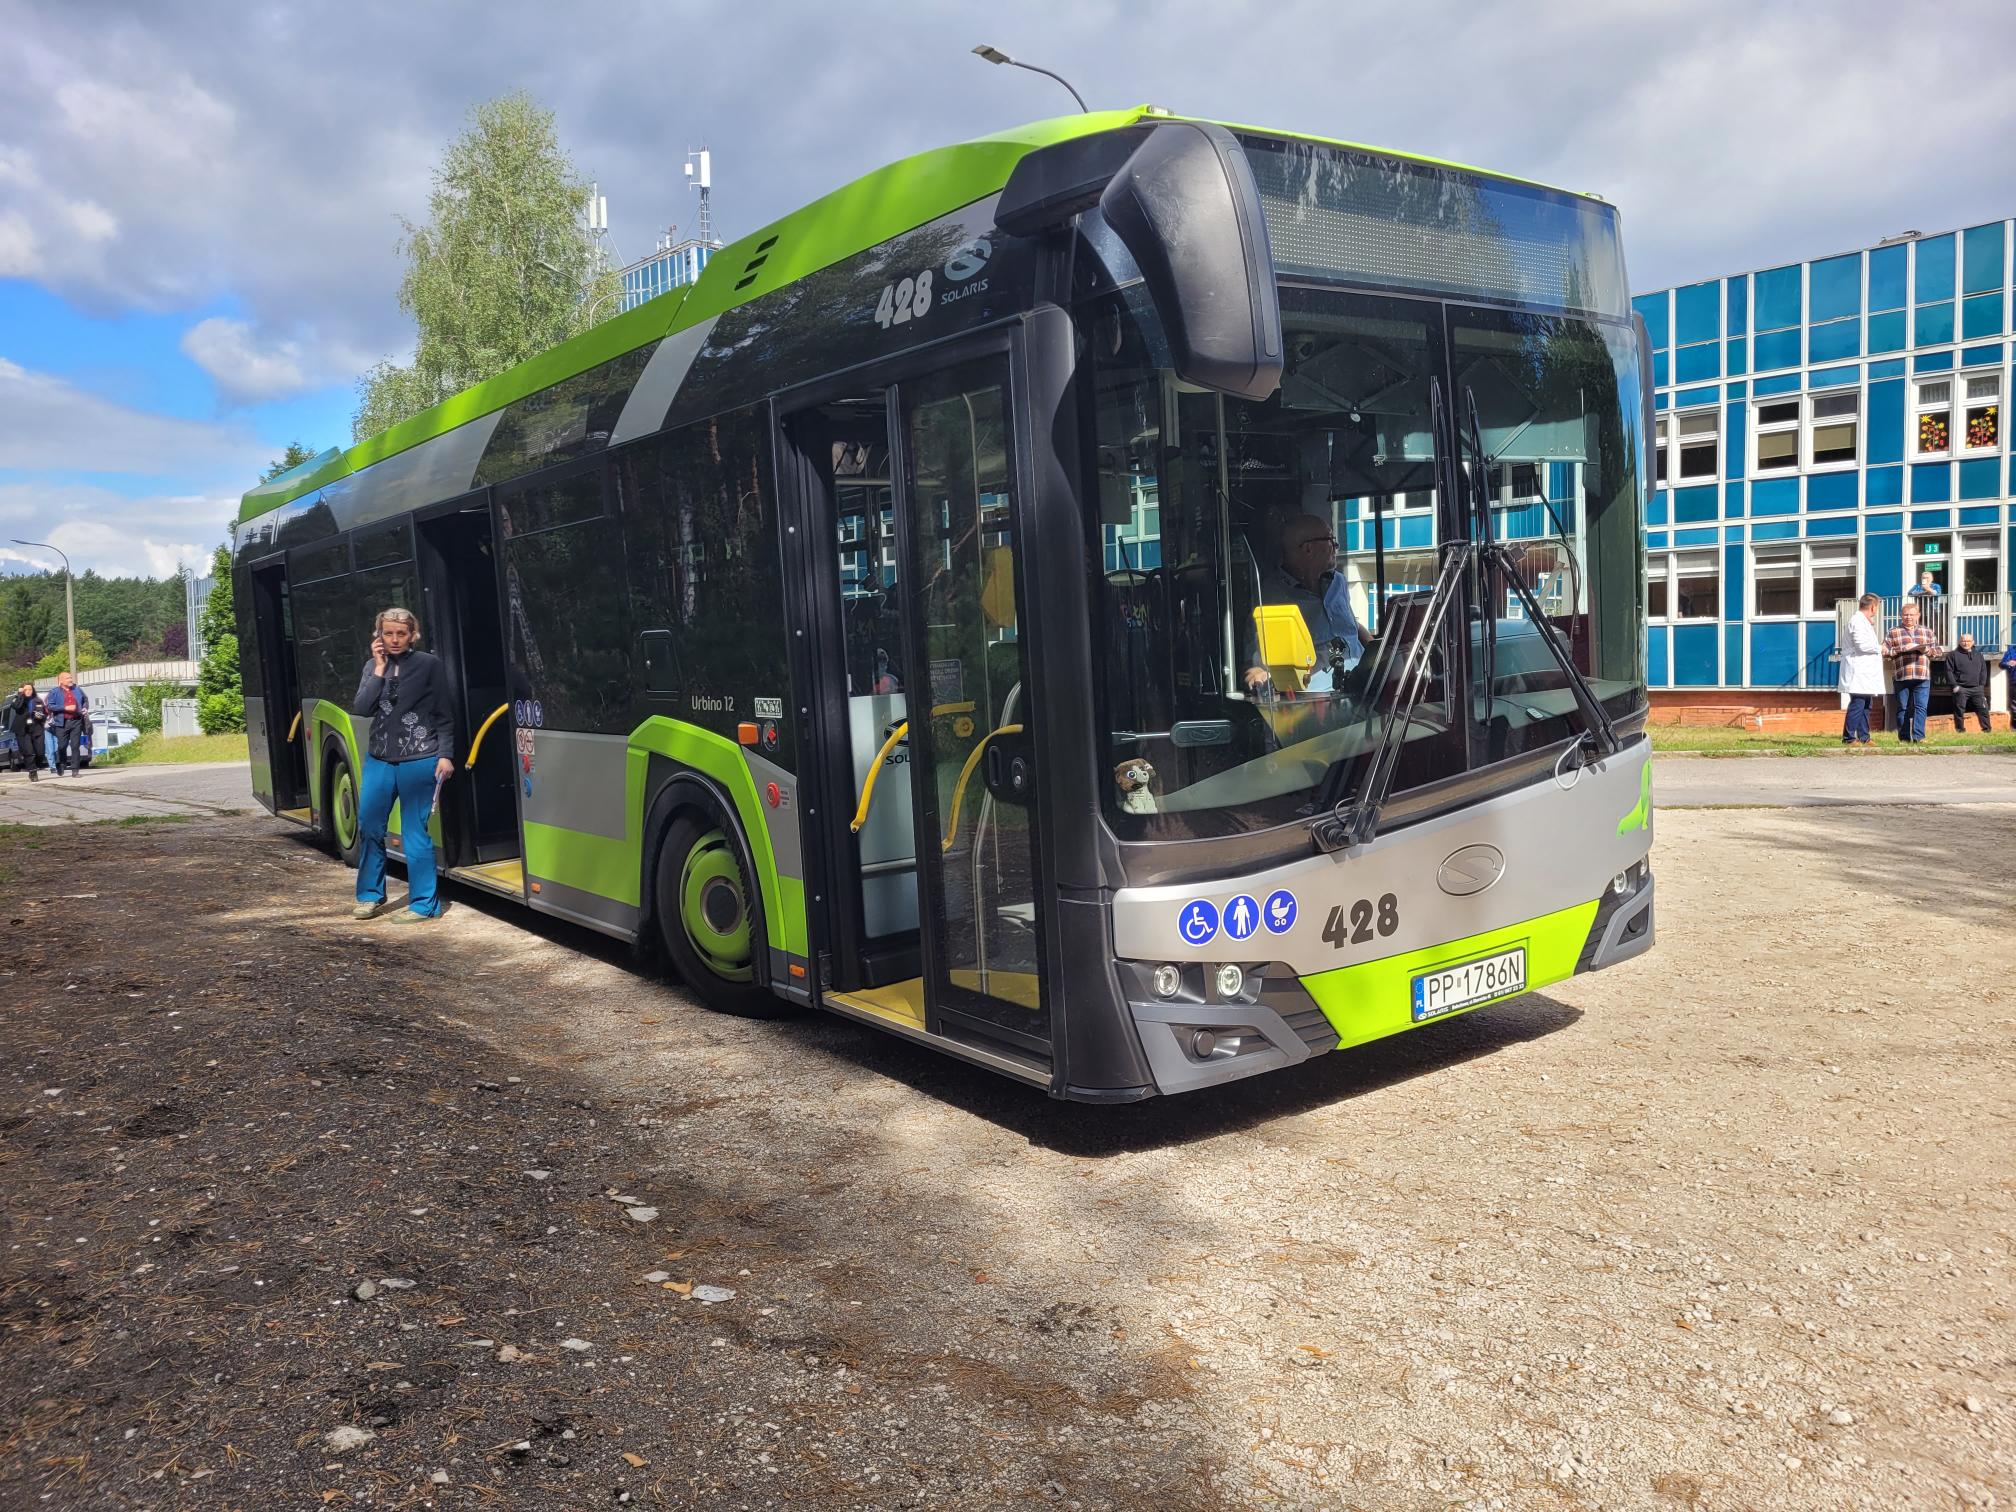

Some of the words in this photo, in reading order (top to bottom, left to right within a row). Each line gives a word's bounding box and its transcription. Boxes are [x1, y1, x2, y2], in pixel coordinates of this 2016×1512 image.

[874, 270, 933, 329] 428
[940, 278, 989, 305] SOLARIS
[691, 695, 722, 711] Urbino
[724, 696, 735, 712] 12
[1321, 892, 1399, 949] 428
[1416, 1000, 1423, 1008] PL
